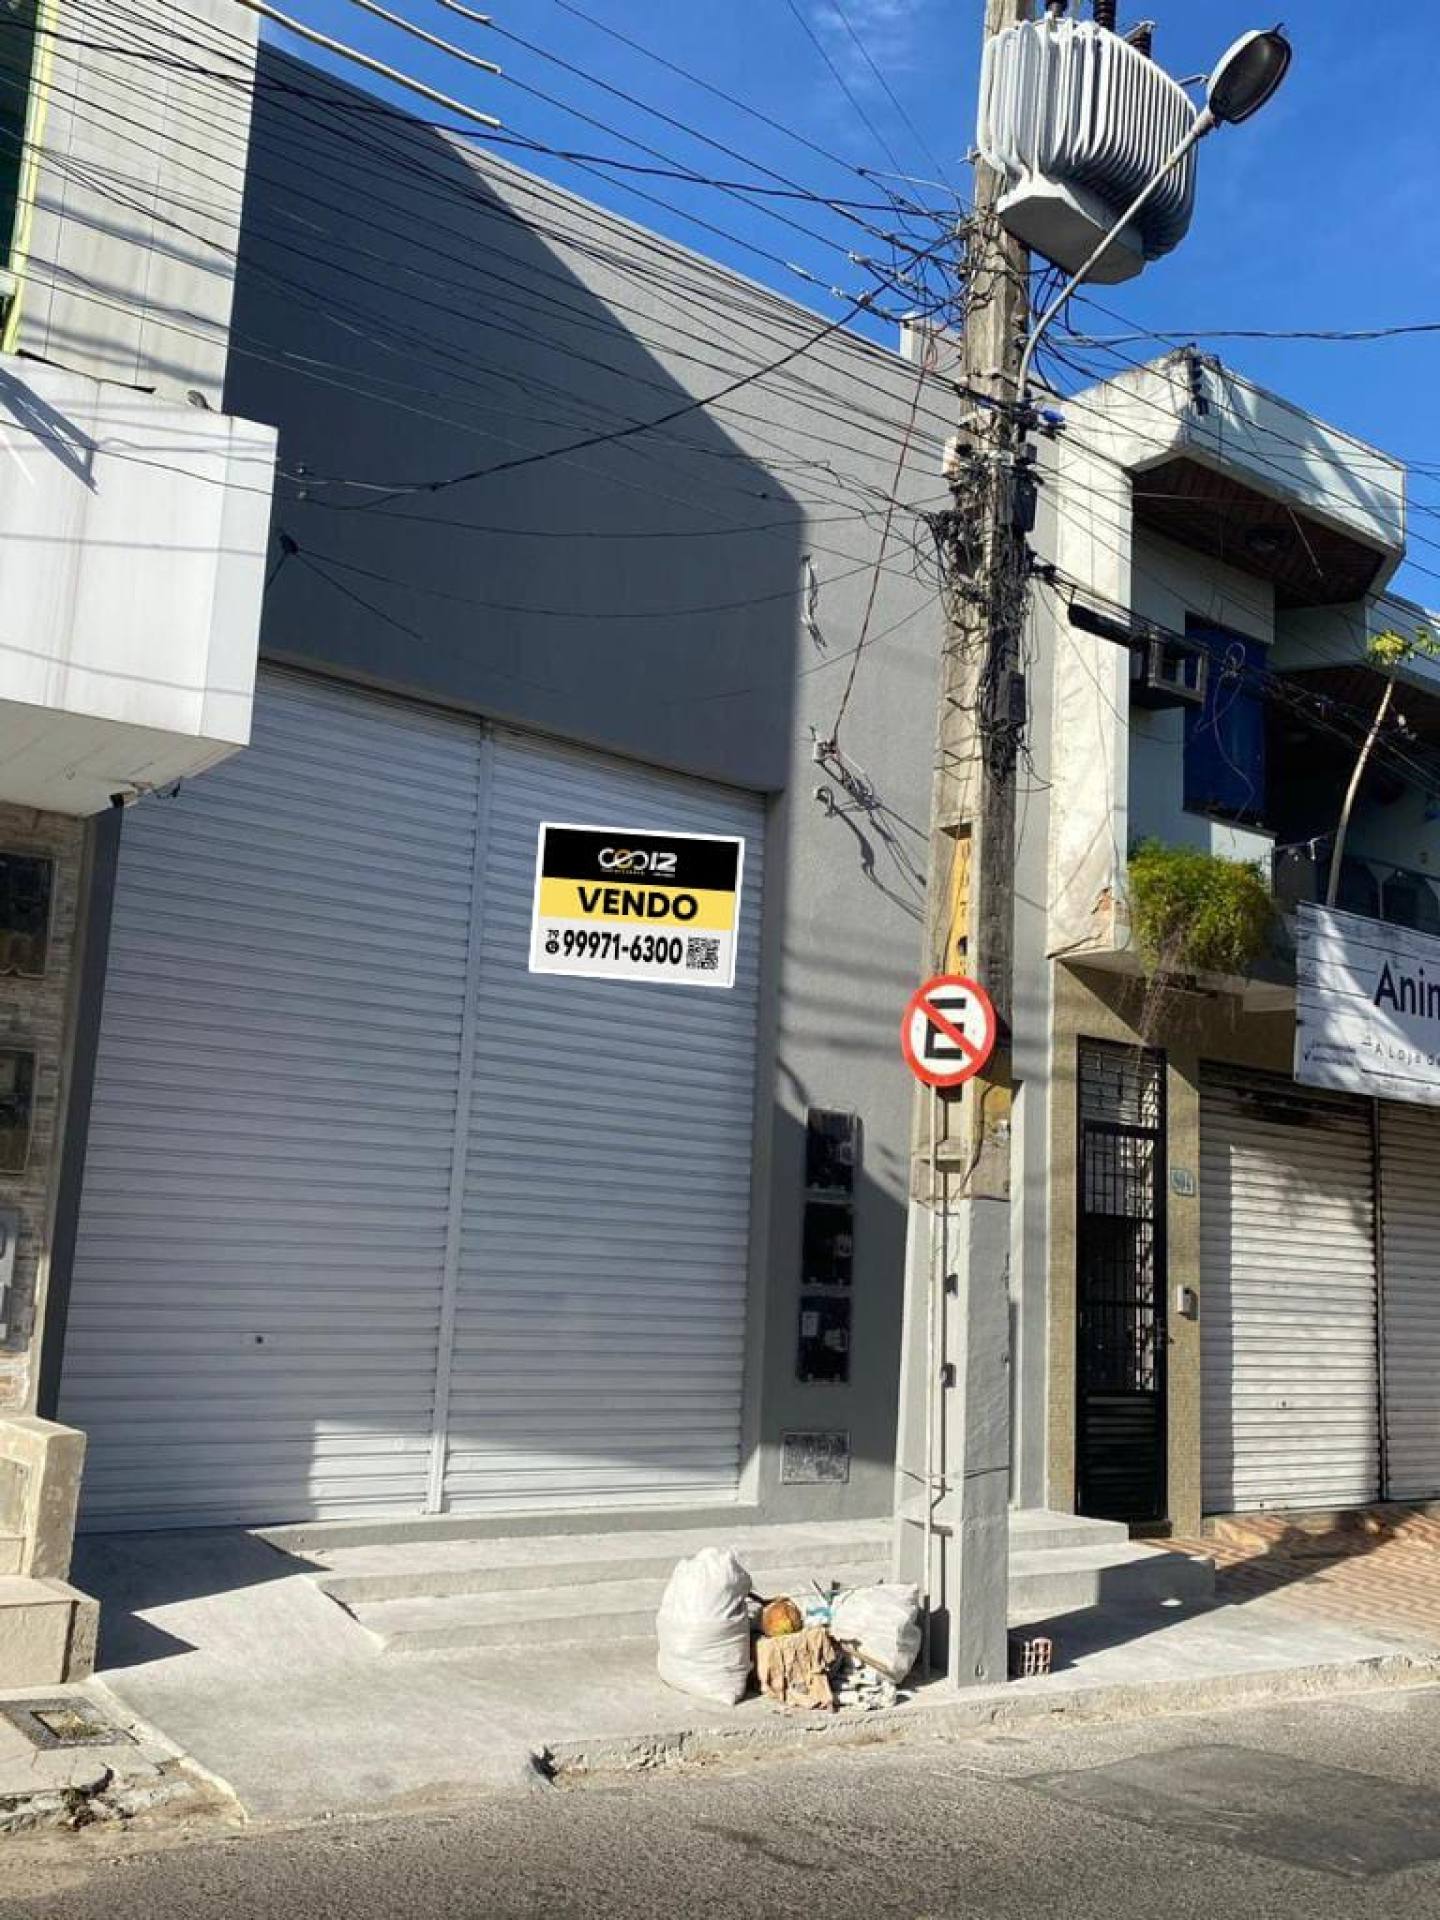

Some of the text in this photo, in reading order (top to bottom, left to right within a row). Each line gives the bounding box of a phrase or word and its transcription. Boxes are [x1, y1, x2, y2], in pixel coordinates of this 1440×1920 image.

[577, 886, 698, 920] VENDO
[563, 929, 683, 965] 99971-6300
[924, 998, 967, 1060] E
